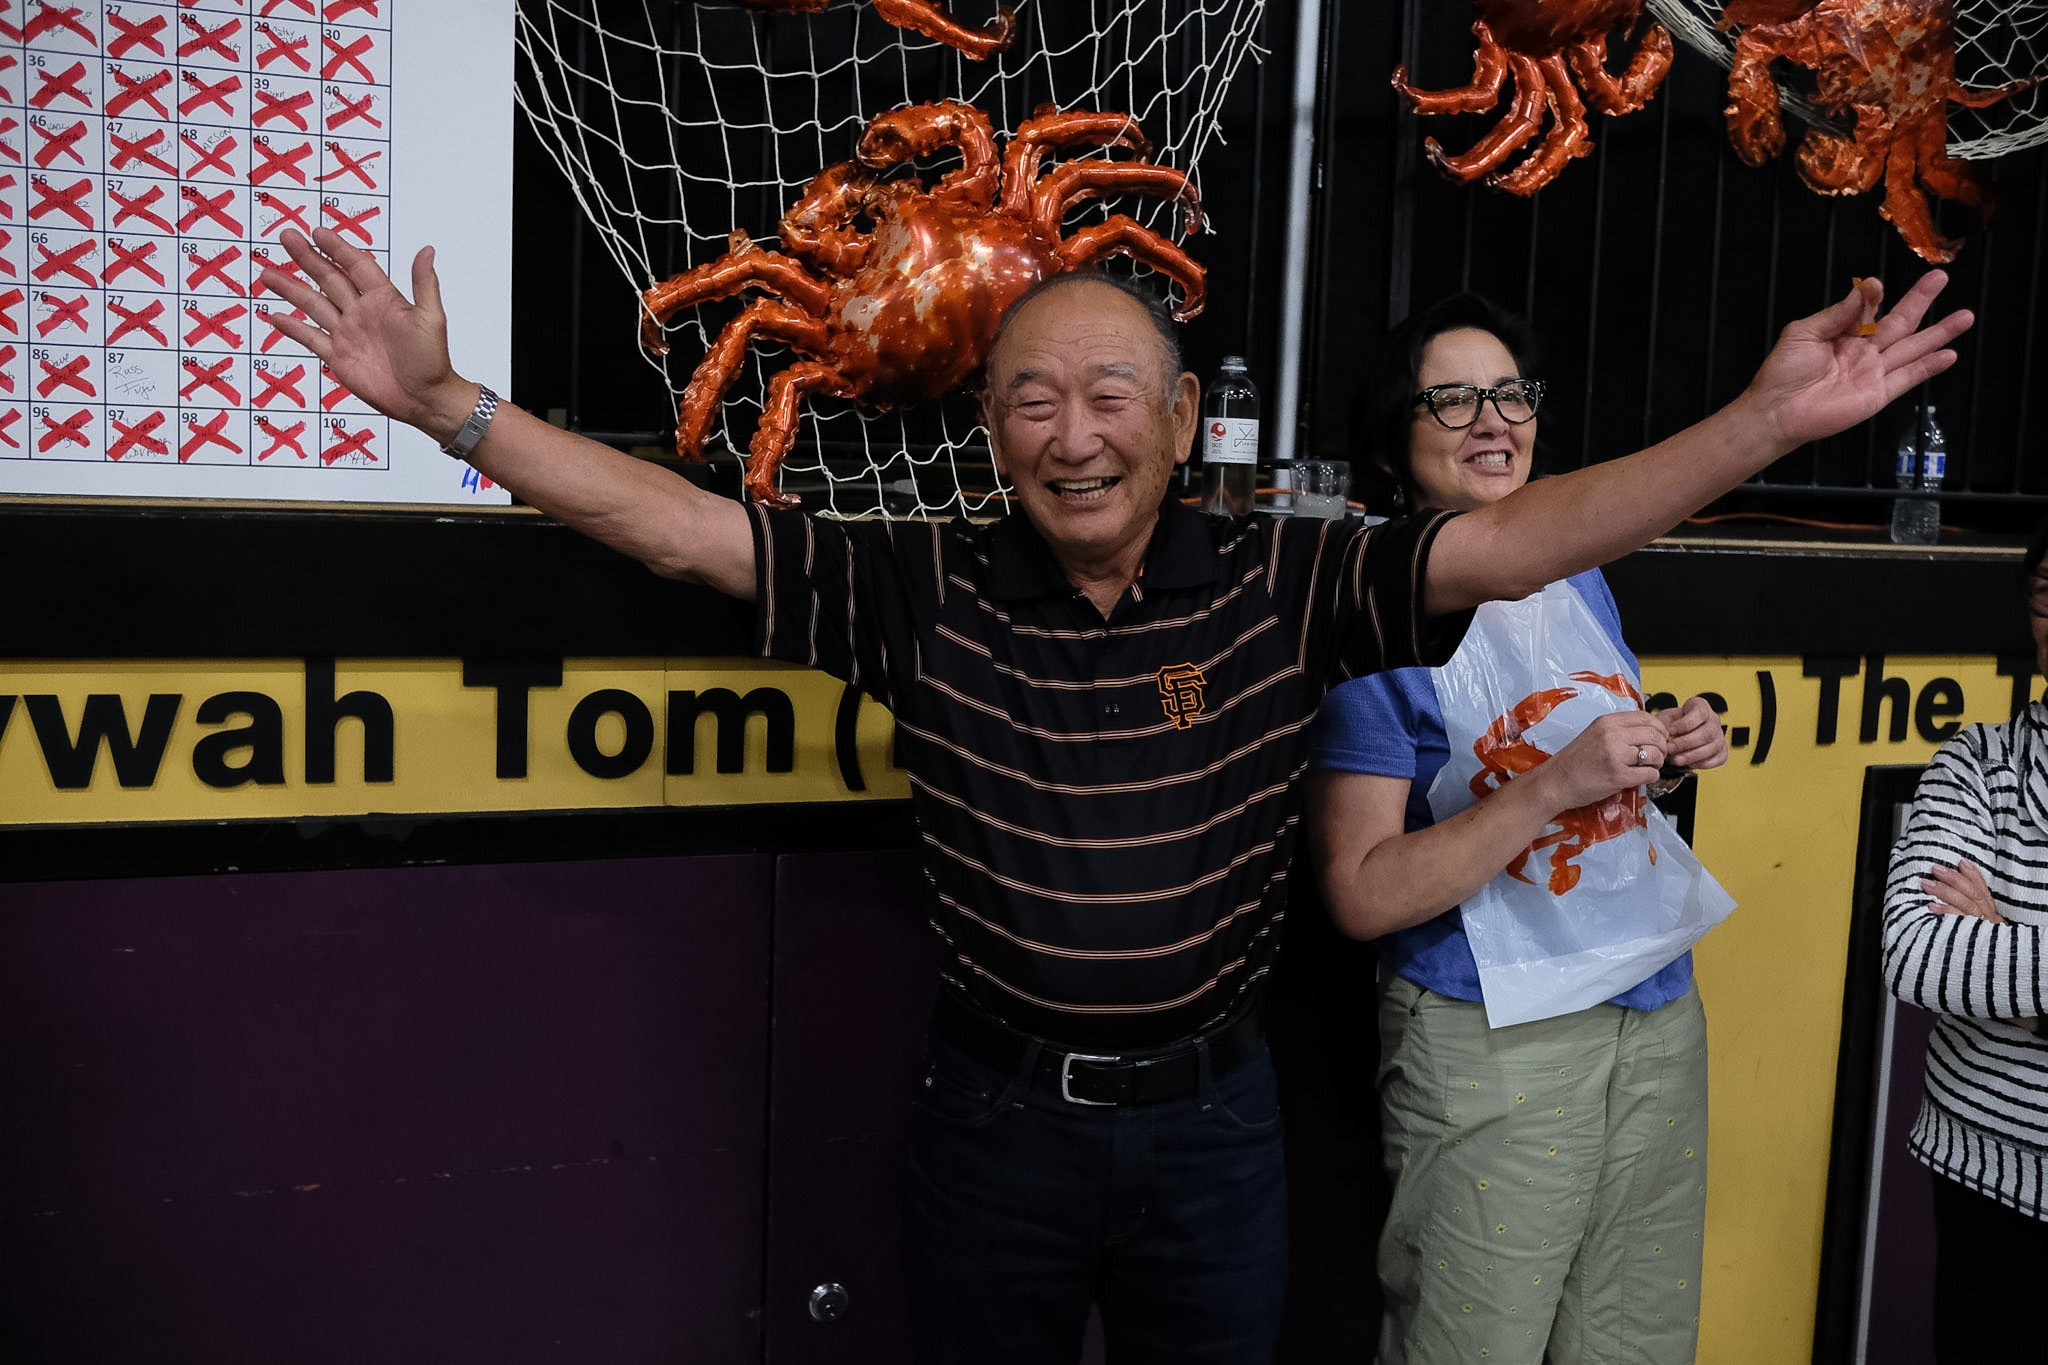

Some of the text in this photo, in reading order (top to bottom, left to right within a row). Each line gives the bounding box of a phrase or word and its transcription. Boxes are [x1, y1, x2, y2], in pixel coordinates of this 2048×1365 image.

[105, 4, 121, 15] 27
[181, 13, 197, 24] 28
[254, 21, 269, 32] 29
[325, 29, 340, 40] 30
[28, 55, 46, 66] 36
[106, 63, 122, 74] 37
[181, 70, 197, 82] 38
[253, 79, 269, 89] 39
[324, 85, 340, 96] 40
[29, 115, 46, 126] 46
[106, 122, 123, 133] 47
[181, 129, 197, 140] 48
[253, 135, 269, 146] 49
[324, 141, 339, 151] 50
[30, 174, 47, 185] 56
[107, 180, 123, 191] 57
[181, 186, 197, 197] 58
[253, 192, 269, 202] 59
[324, 197, 339, 207] 60
[31, 232, 48, 244] 66
[107, 238, 123, 249] 67
[182, 243, 197, 254] 68
[253, 248, 269, 258] 69
[32, 291, 48, 302] 76
[108, 296, 124, 306] 77
[181, 300, 197, 310] 78
[254, 304, 269, 314] 79
[32, 349, 49, 360] 86
[108, 353, 124, 363] 87
[182, 356, 197, 367] 88
[253, 360, 269, 370] 89
[109, 365, 144, 379] Russ
[33, 407, 49, 418] 96
[108, 410, 124, 421] 97
[182, 413, 197, 424] 98
[253, 415, 269, 425] 99
[323, 418, 346, 428] 100
[1157, 662, 1207, 730] SF
[0, 657, 395, 788] wah
[462, 656, 795, 779] Tom
[1803, 655, 1964, 746] The
